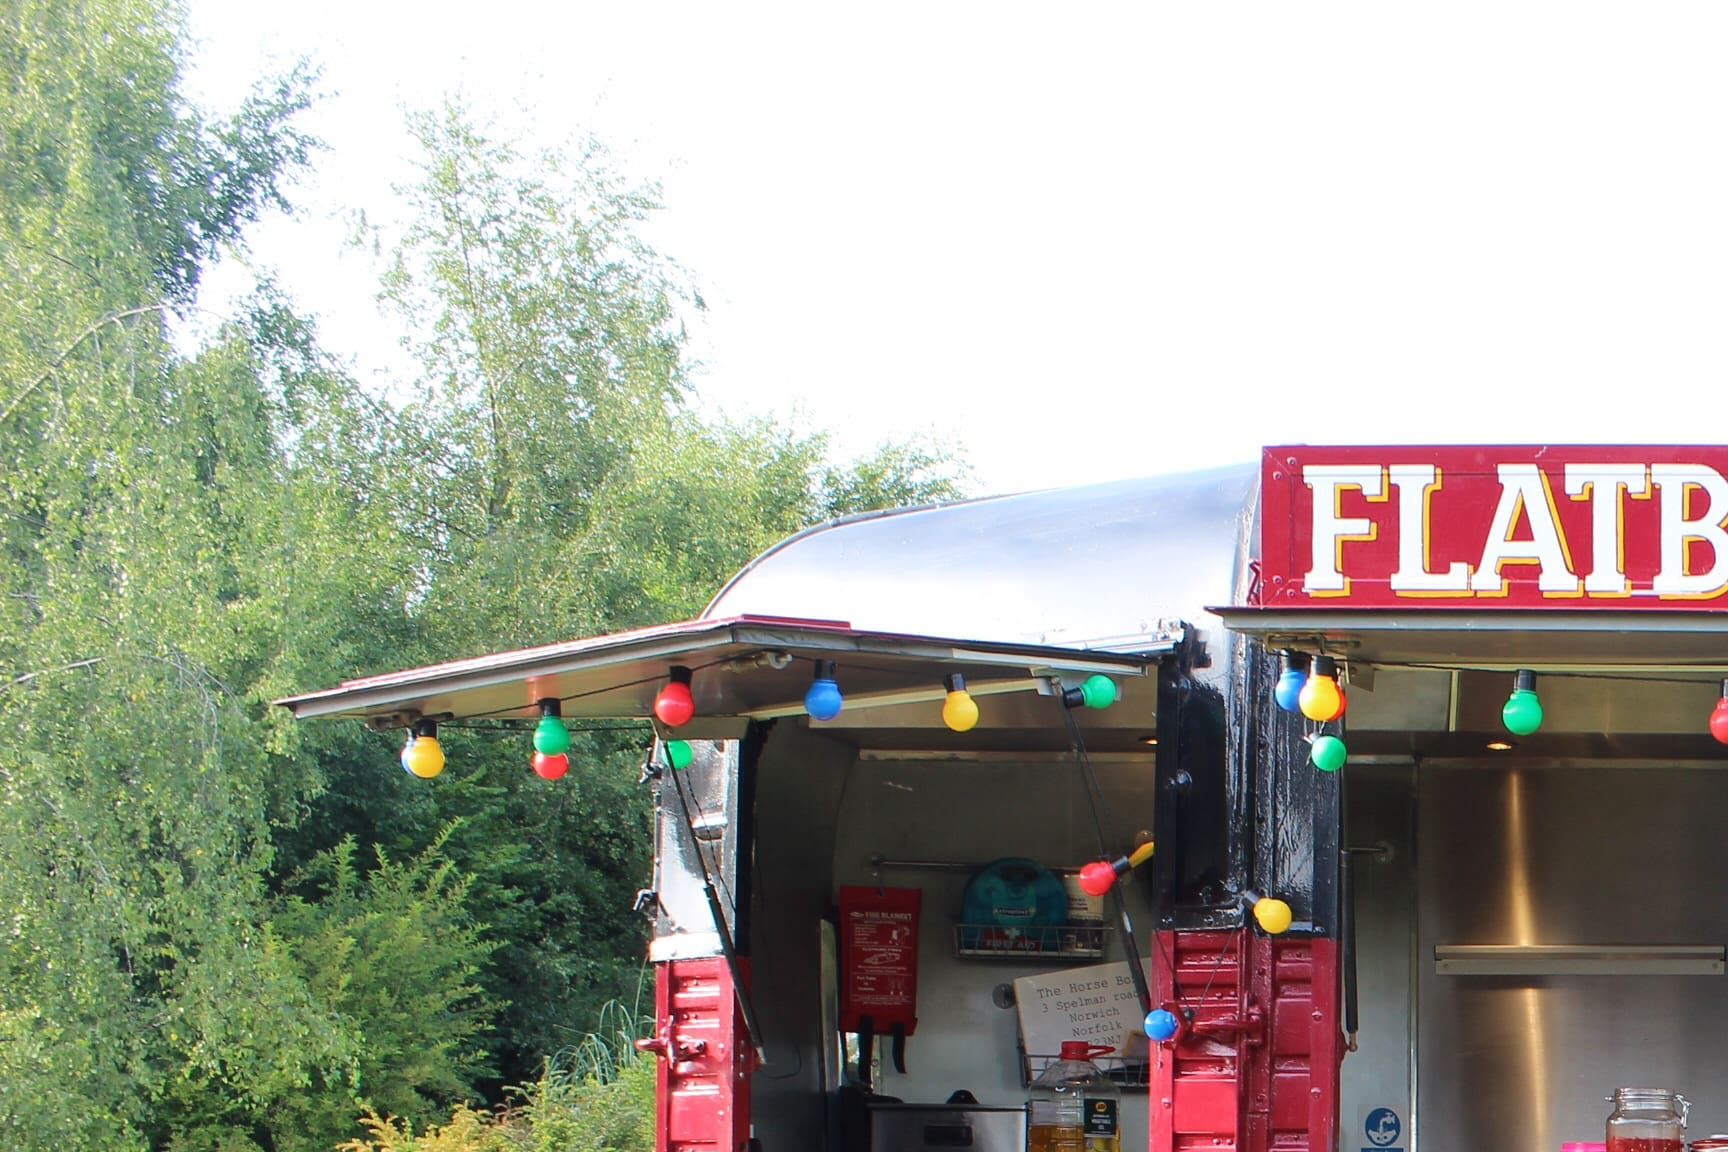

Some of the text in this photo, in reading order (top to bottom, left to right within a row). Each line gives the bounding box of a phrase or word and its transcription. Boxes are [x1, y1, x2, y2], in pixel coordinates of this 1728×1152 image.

[1036, 986, 1061, 998] The
[1069, 980, 1108, 993] Horse
[1041, 1003, 1049, 1013] 3
[1056, 994, 1106, 1012] Spelman
[1069, 1006, 1120, 1023] Norwich
[1072, 1021, 1123, 1037] Norfolk
